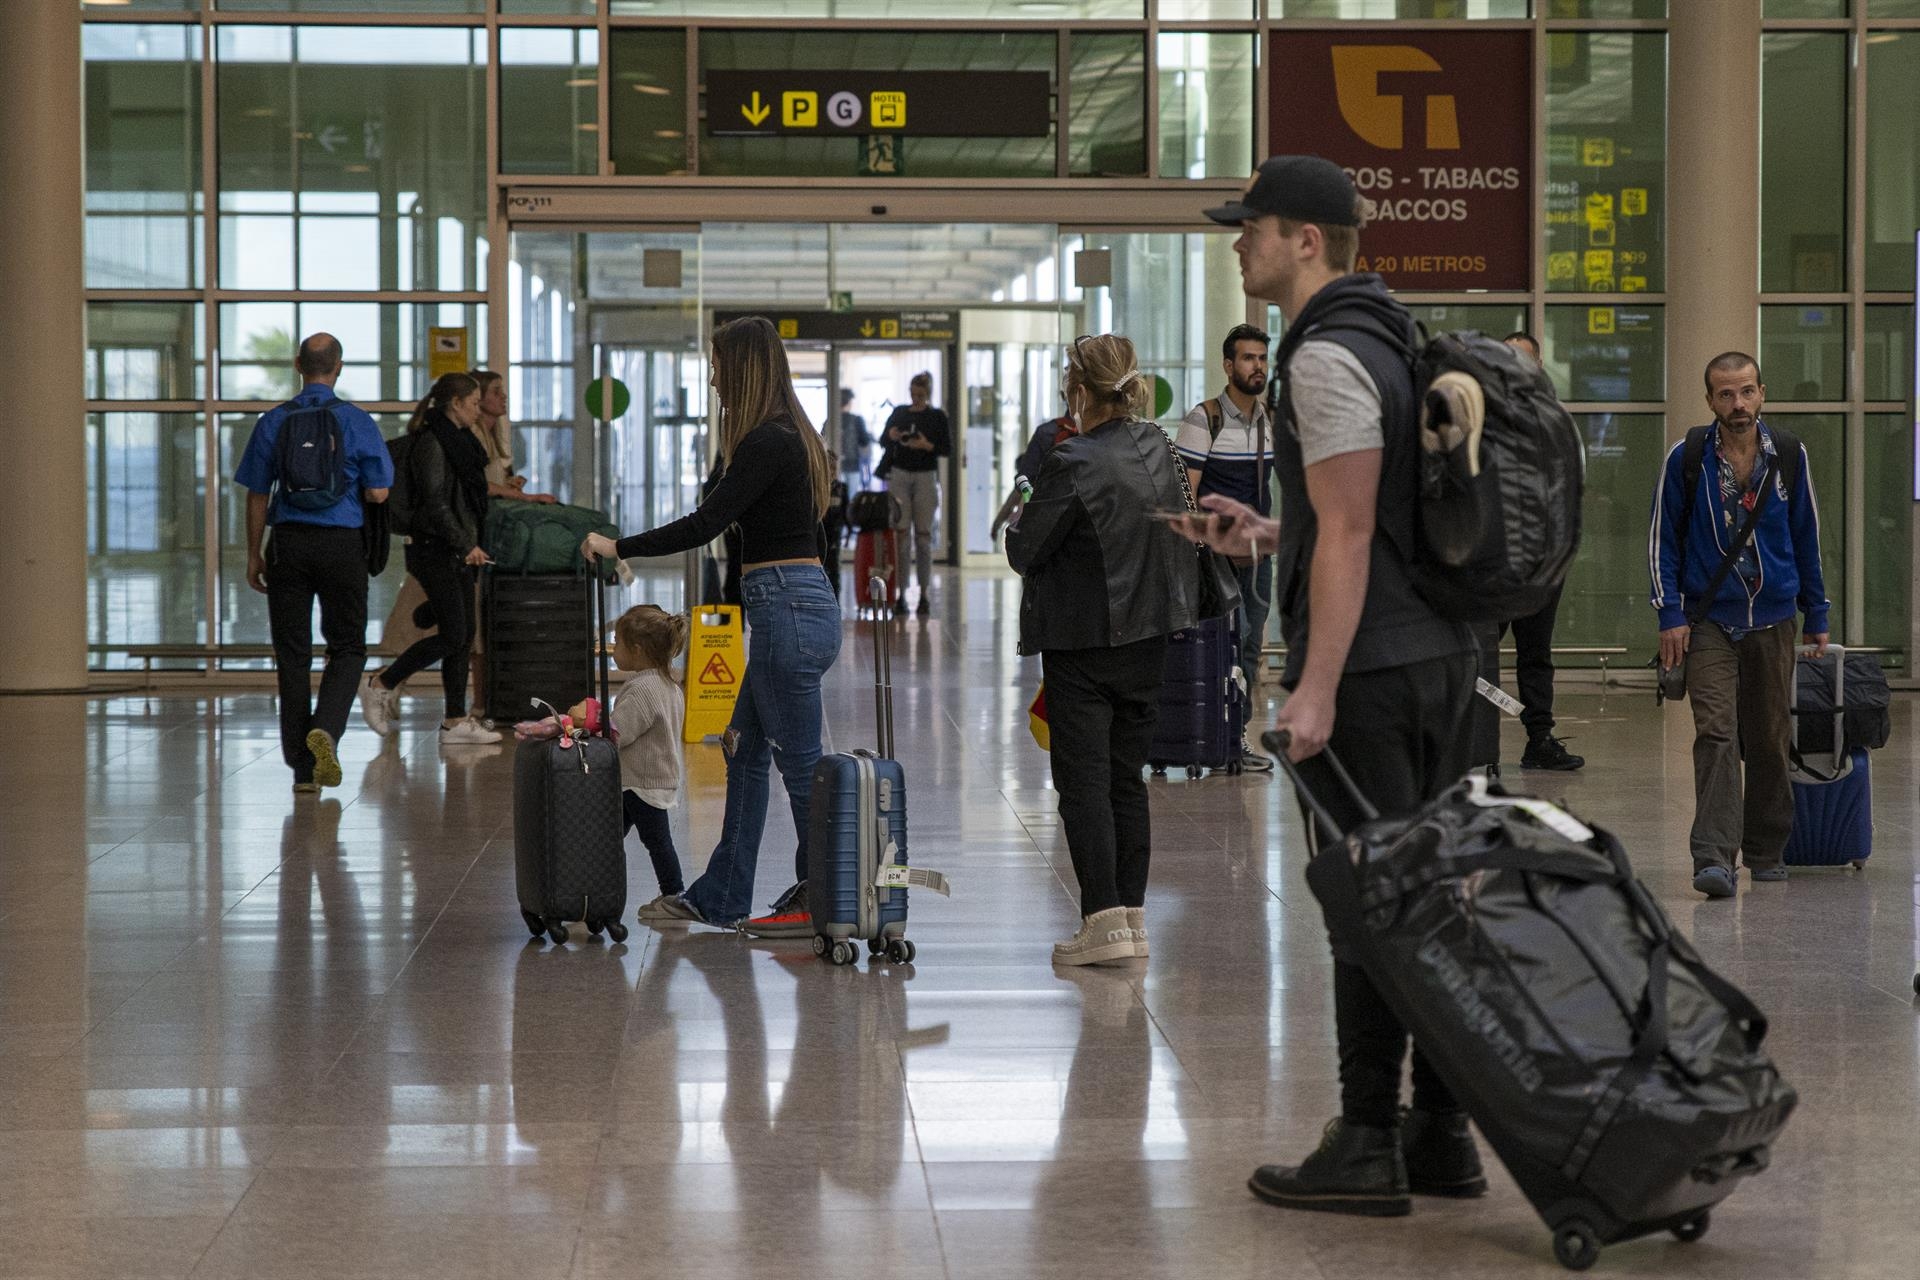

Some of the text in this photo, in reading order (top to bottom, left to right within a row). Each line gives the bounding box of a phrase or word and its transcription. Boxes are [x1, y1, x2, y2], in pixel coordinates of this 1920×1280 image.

[793, 95, 903, 121] P G HOTEL
[1418, 167, 1520, 190] TABACS
[508, 197, 551, 206] PCP-111
[1375, 255, 1397, 272] 20
[1403, 255, 1487, 273] METROS
